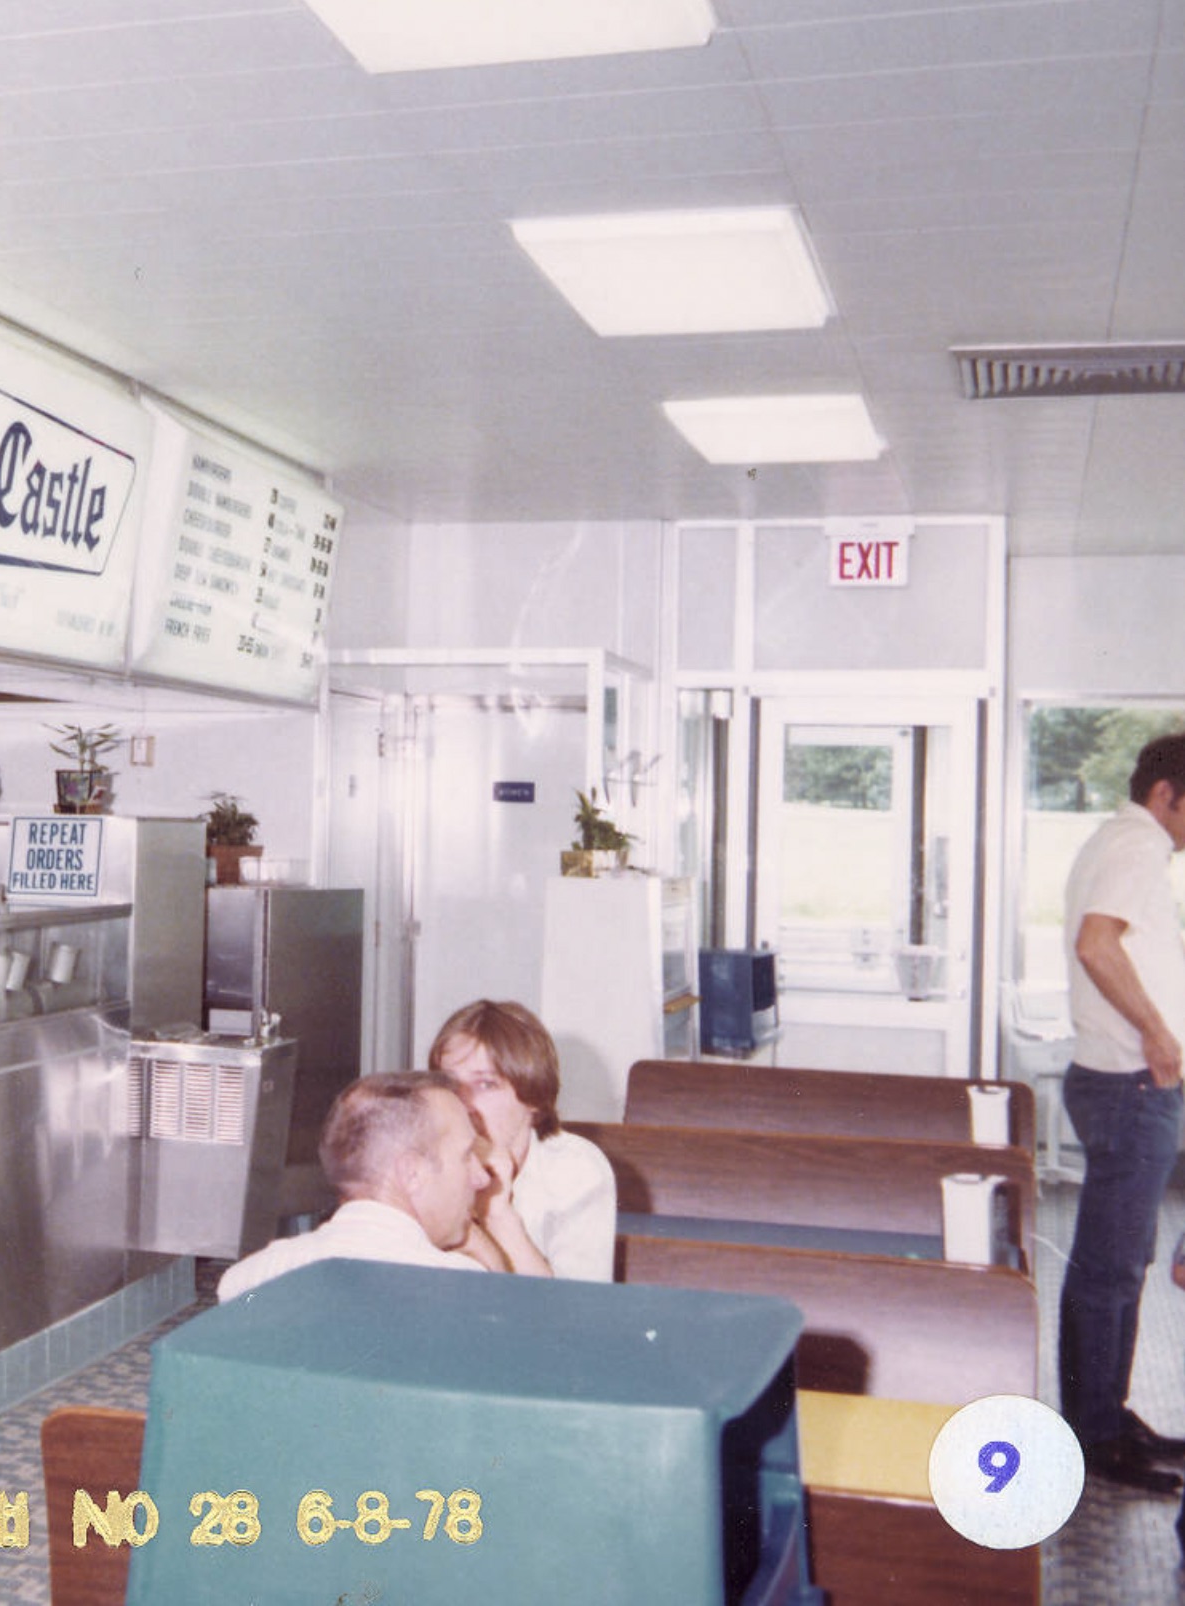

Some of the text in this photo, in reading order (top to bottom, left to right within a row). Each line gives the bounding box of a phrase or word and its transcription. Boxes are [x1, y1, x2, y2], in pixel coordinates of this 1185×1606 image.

[839, 541, 899, 579] EXIT
[28, 823, 87, 845] REPEAT
[26, 848, 83, 871] ORDERS
[12, 871, 94, 890] FILLED HERE
